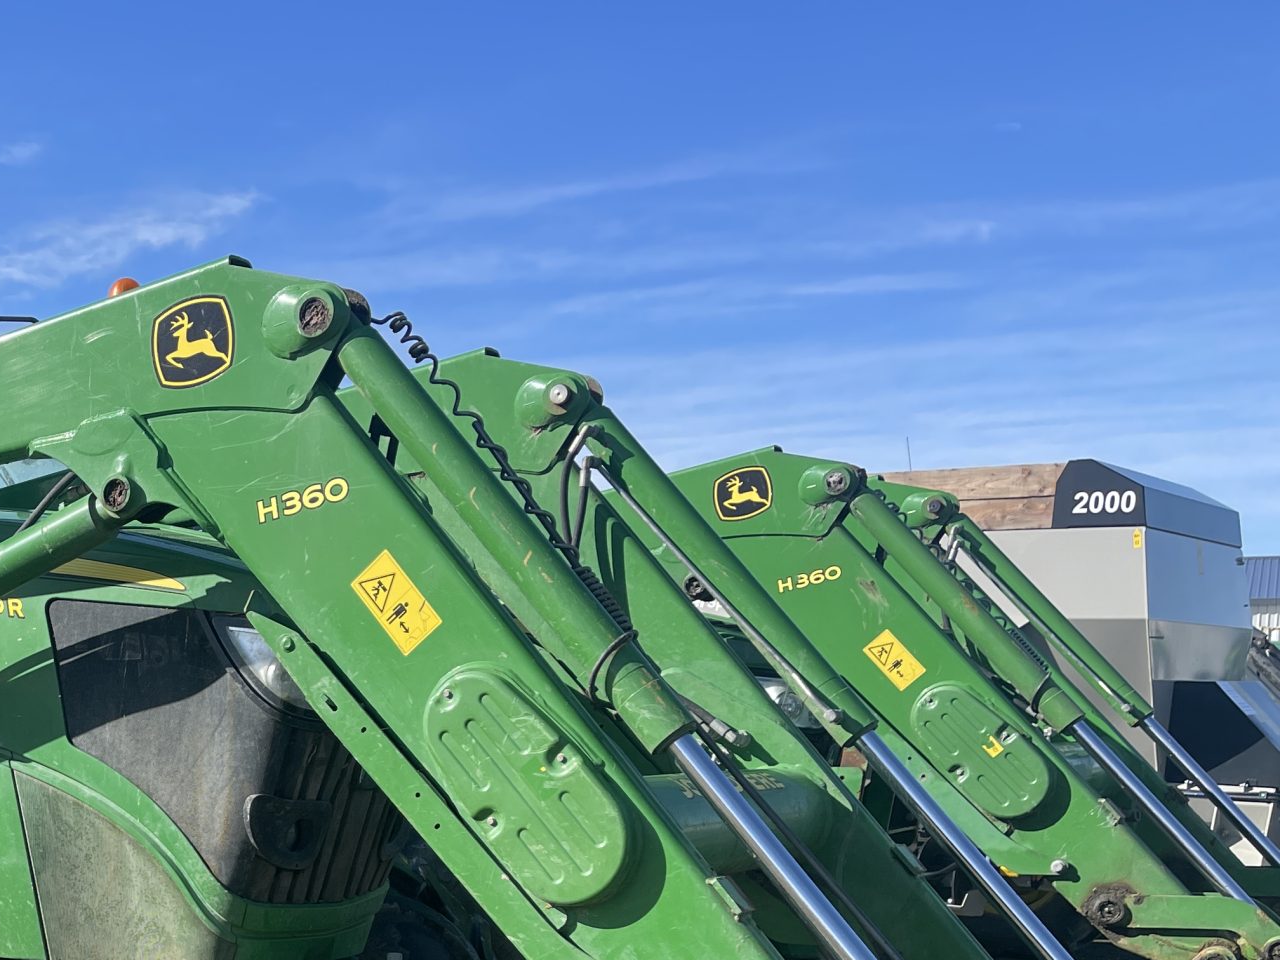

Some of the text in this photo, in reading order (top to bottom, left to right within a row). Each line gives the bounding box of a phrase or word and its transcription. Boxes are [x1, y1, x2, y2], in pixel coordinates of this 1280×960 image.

[256, 476, 350, 525] H360
[1071, 490, 1137, 514] 2000
[776, 564, 842, 593] H360
